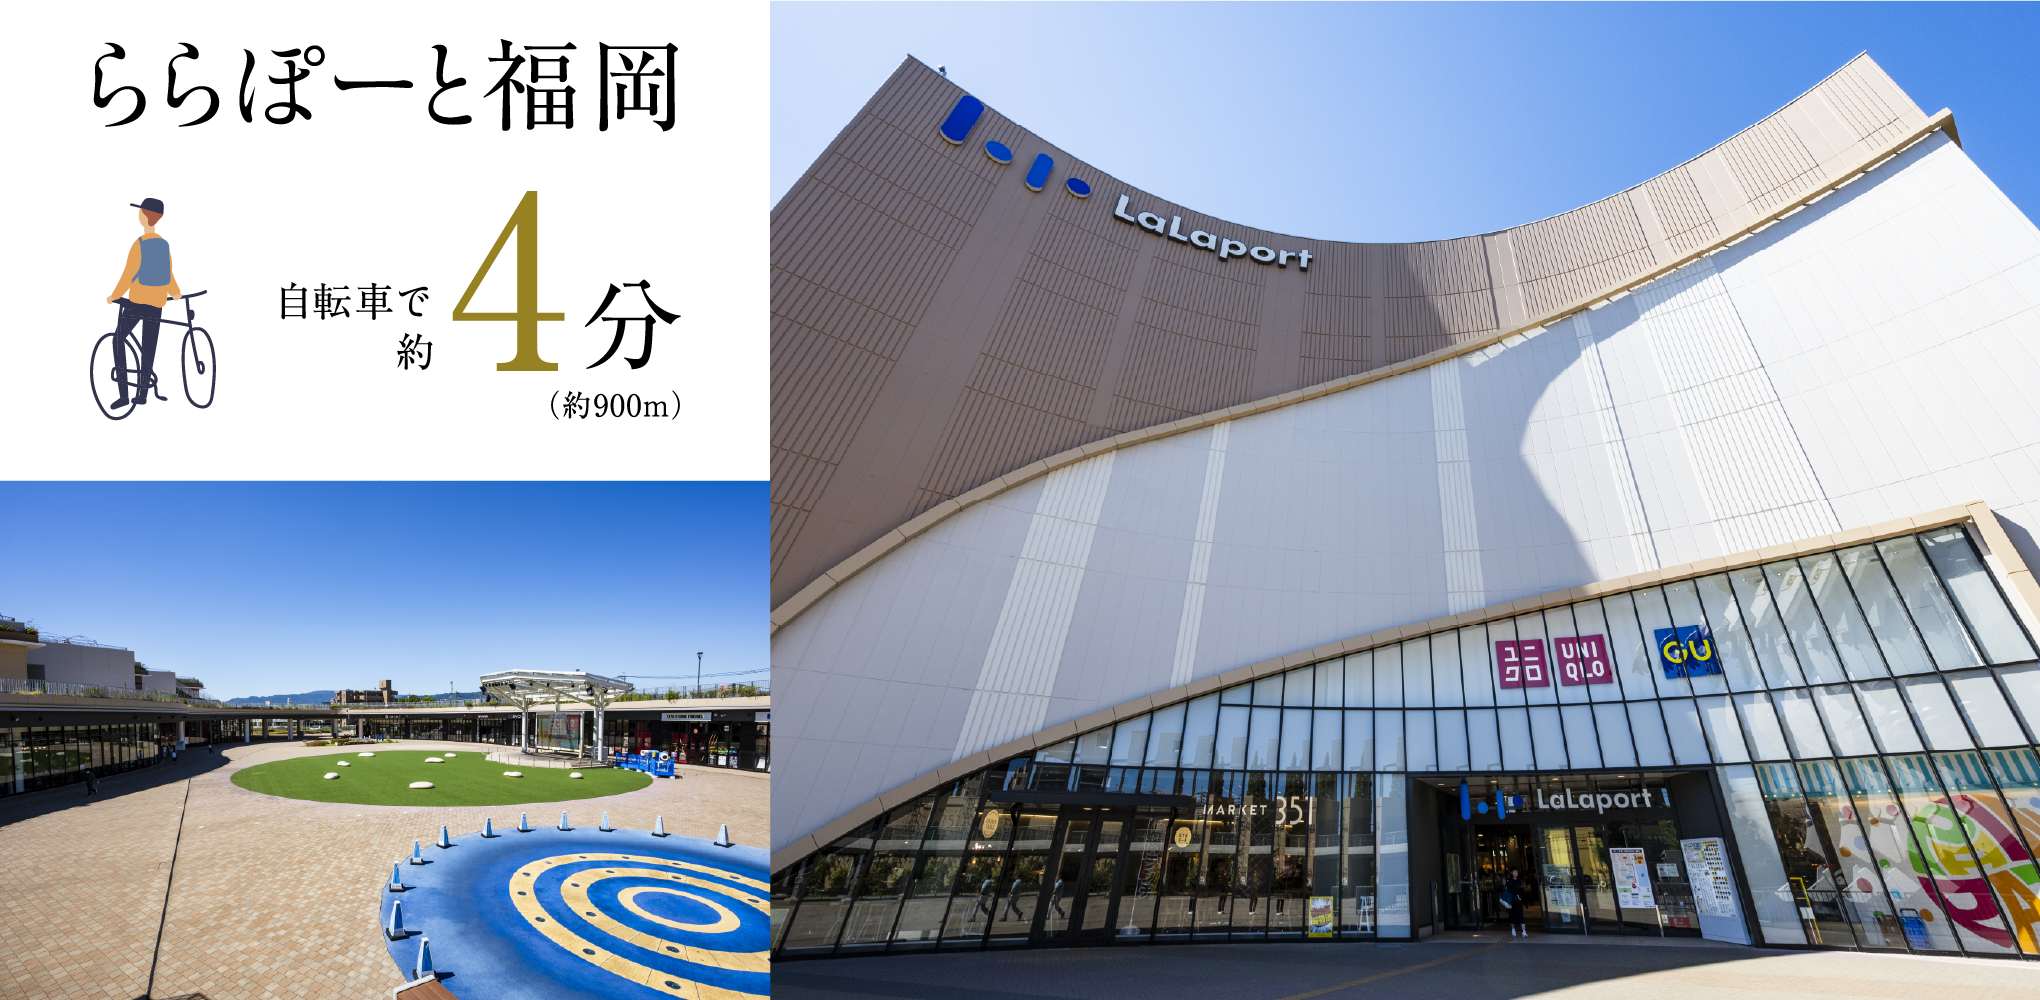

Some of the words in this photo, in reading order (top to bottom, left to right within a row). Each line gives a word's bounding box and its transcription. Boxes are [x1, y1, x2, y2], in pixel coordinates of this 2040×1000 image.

[1114, 194, 1313, 272] LaLaport
[1561, 641, 1598, 659] UNI
[1663, 639, 1712, 664] GU
[1565, 660, 1605, 682] QLO
[1203, 804, 1268, 816] MARKET
[1275, 796, 1313, 825] 351
[1537, 788, 1652, 814] LaLaport
